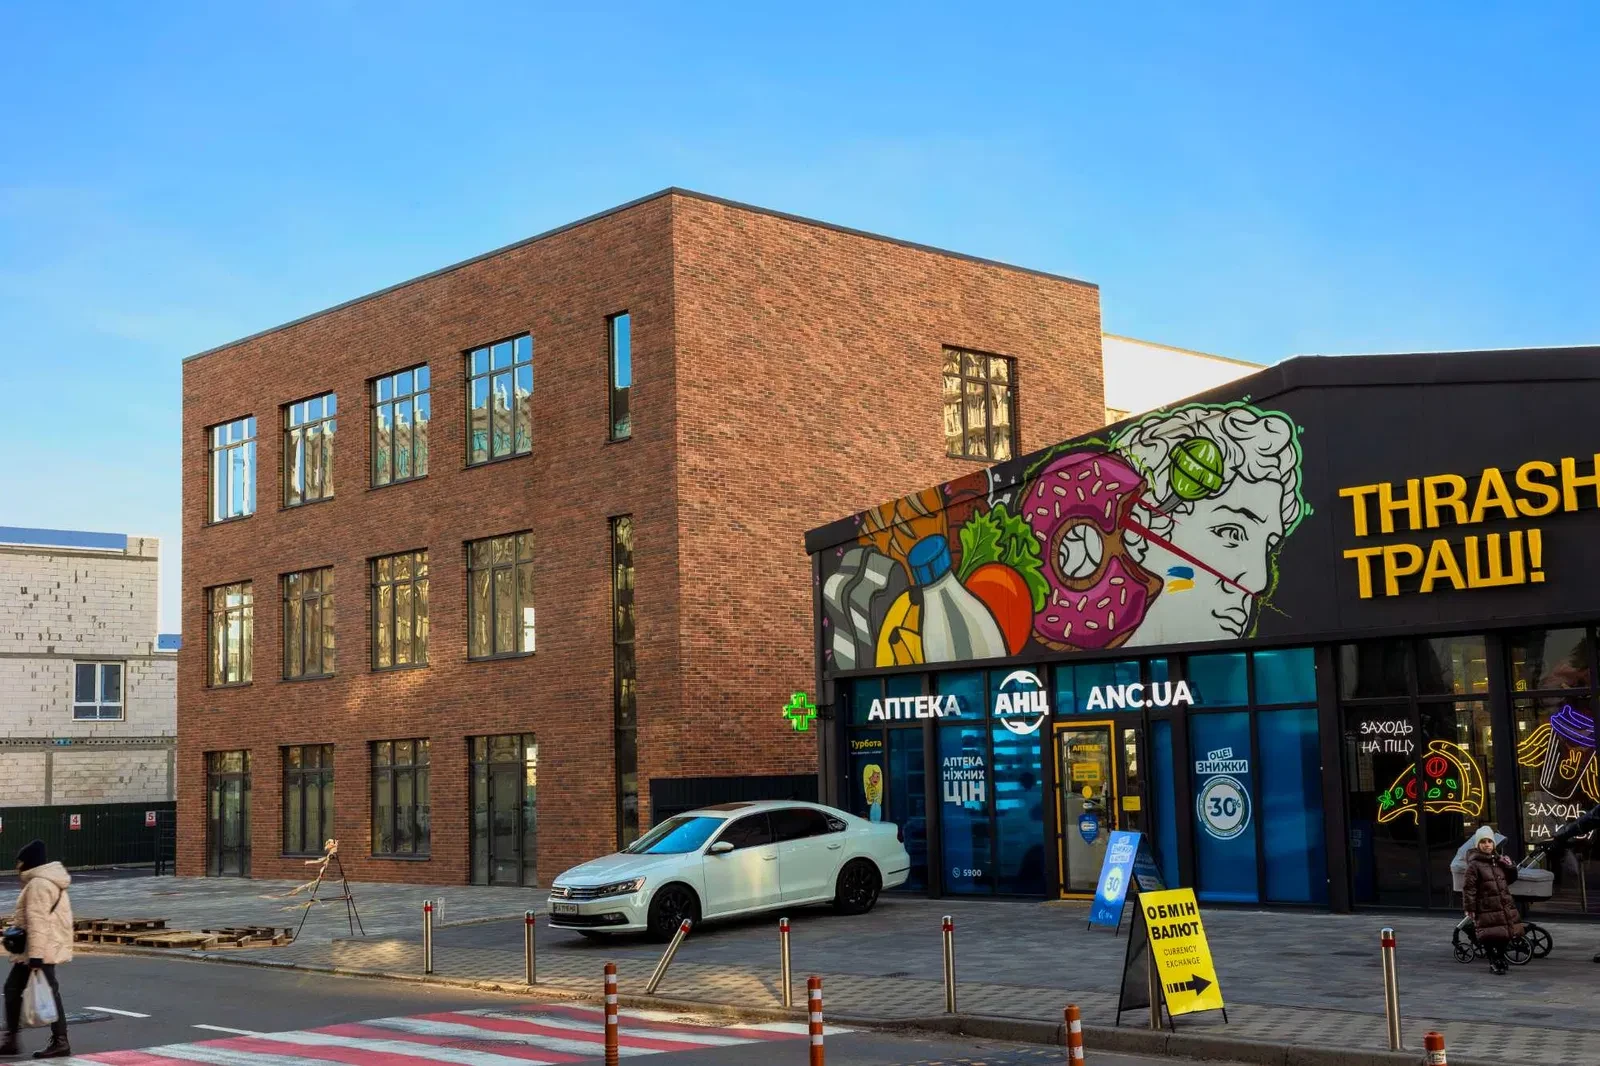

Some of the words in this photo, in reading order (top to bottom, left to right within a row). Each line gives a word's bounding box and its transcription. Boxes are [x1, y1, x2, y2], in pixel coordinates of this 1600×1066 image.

[1339, 453, 1600, 536] THRASH
[1343, 528, 1545, 599] ТРАШ!
[994, 690, 1049, 716] АНЦ
[1086, 680, 1194, 710] ANC.UA
[868, 694, 961, 721] АПТЕКА
[1360, 719, 1413, 736] ЗАХОДЬ
[851, 739, 882, 750] Турбота
[1361, 740, 1381, 753] НА
[1384, 739, 1414, 755] ПІЦУ
[943, 756, 984, 767] АПТЕКА
[1209, 748, 1231, 760] ОЦЕ!
[1197, 761, 1246, 773] ЗНИЖКИ
[943, 780, 986, 806] ЦІН
[148, 812, 154, 821] 5
[1528, 802, 1587, 821] ЗАХОДЬ
[73, 816, 79, 824] 4
[1529, 824, 1551, 838] НА
[963, 869, 982, 877] 5900
[1147, 902, 1196, 920] ОБМІН
[1151, 921, 1199, 940] ВАЛЮТ
[1164, 945, 1197, 956] CURRENCY
[1166, 956, 1200, 968] EXCHANGE
